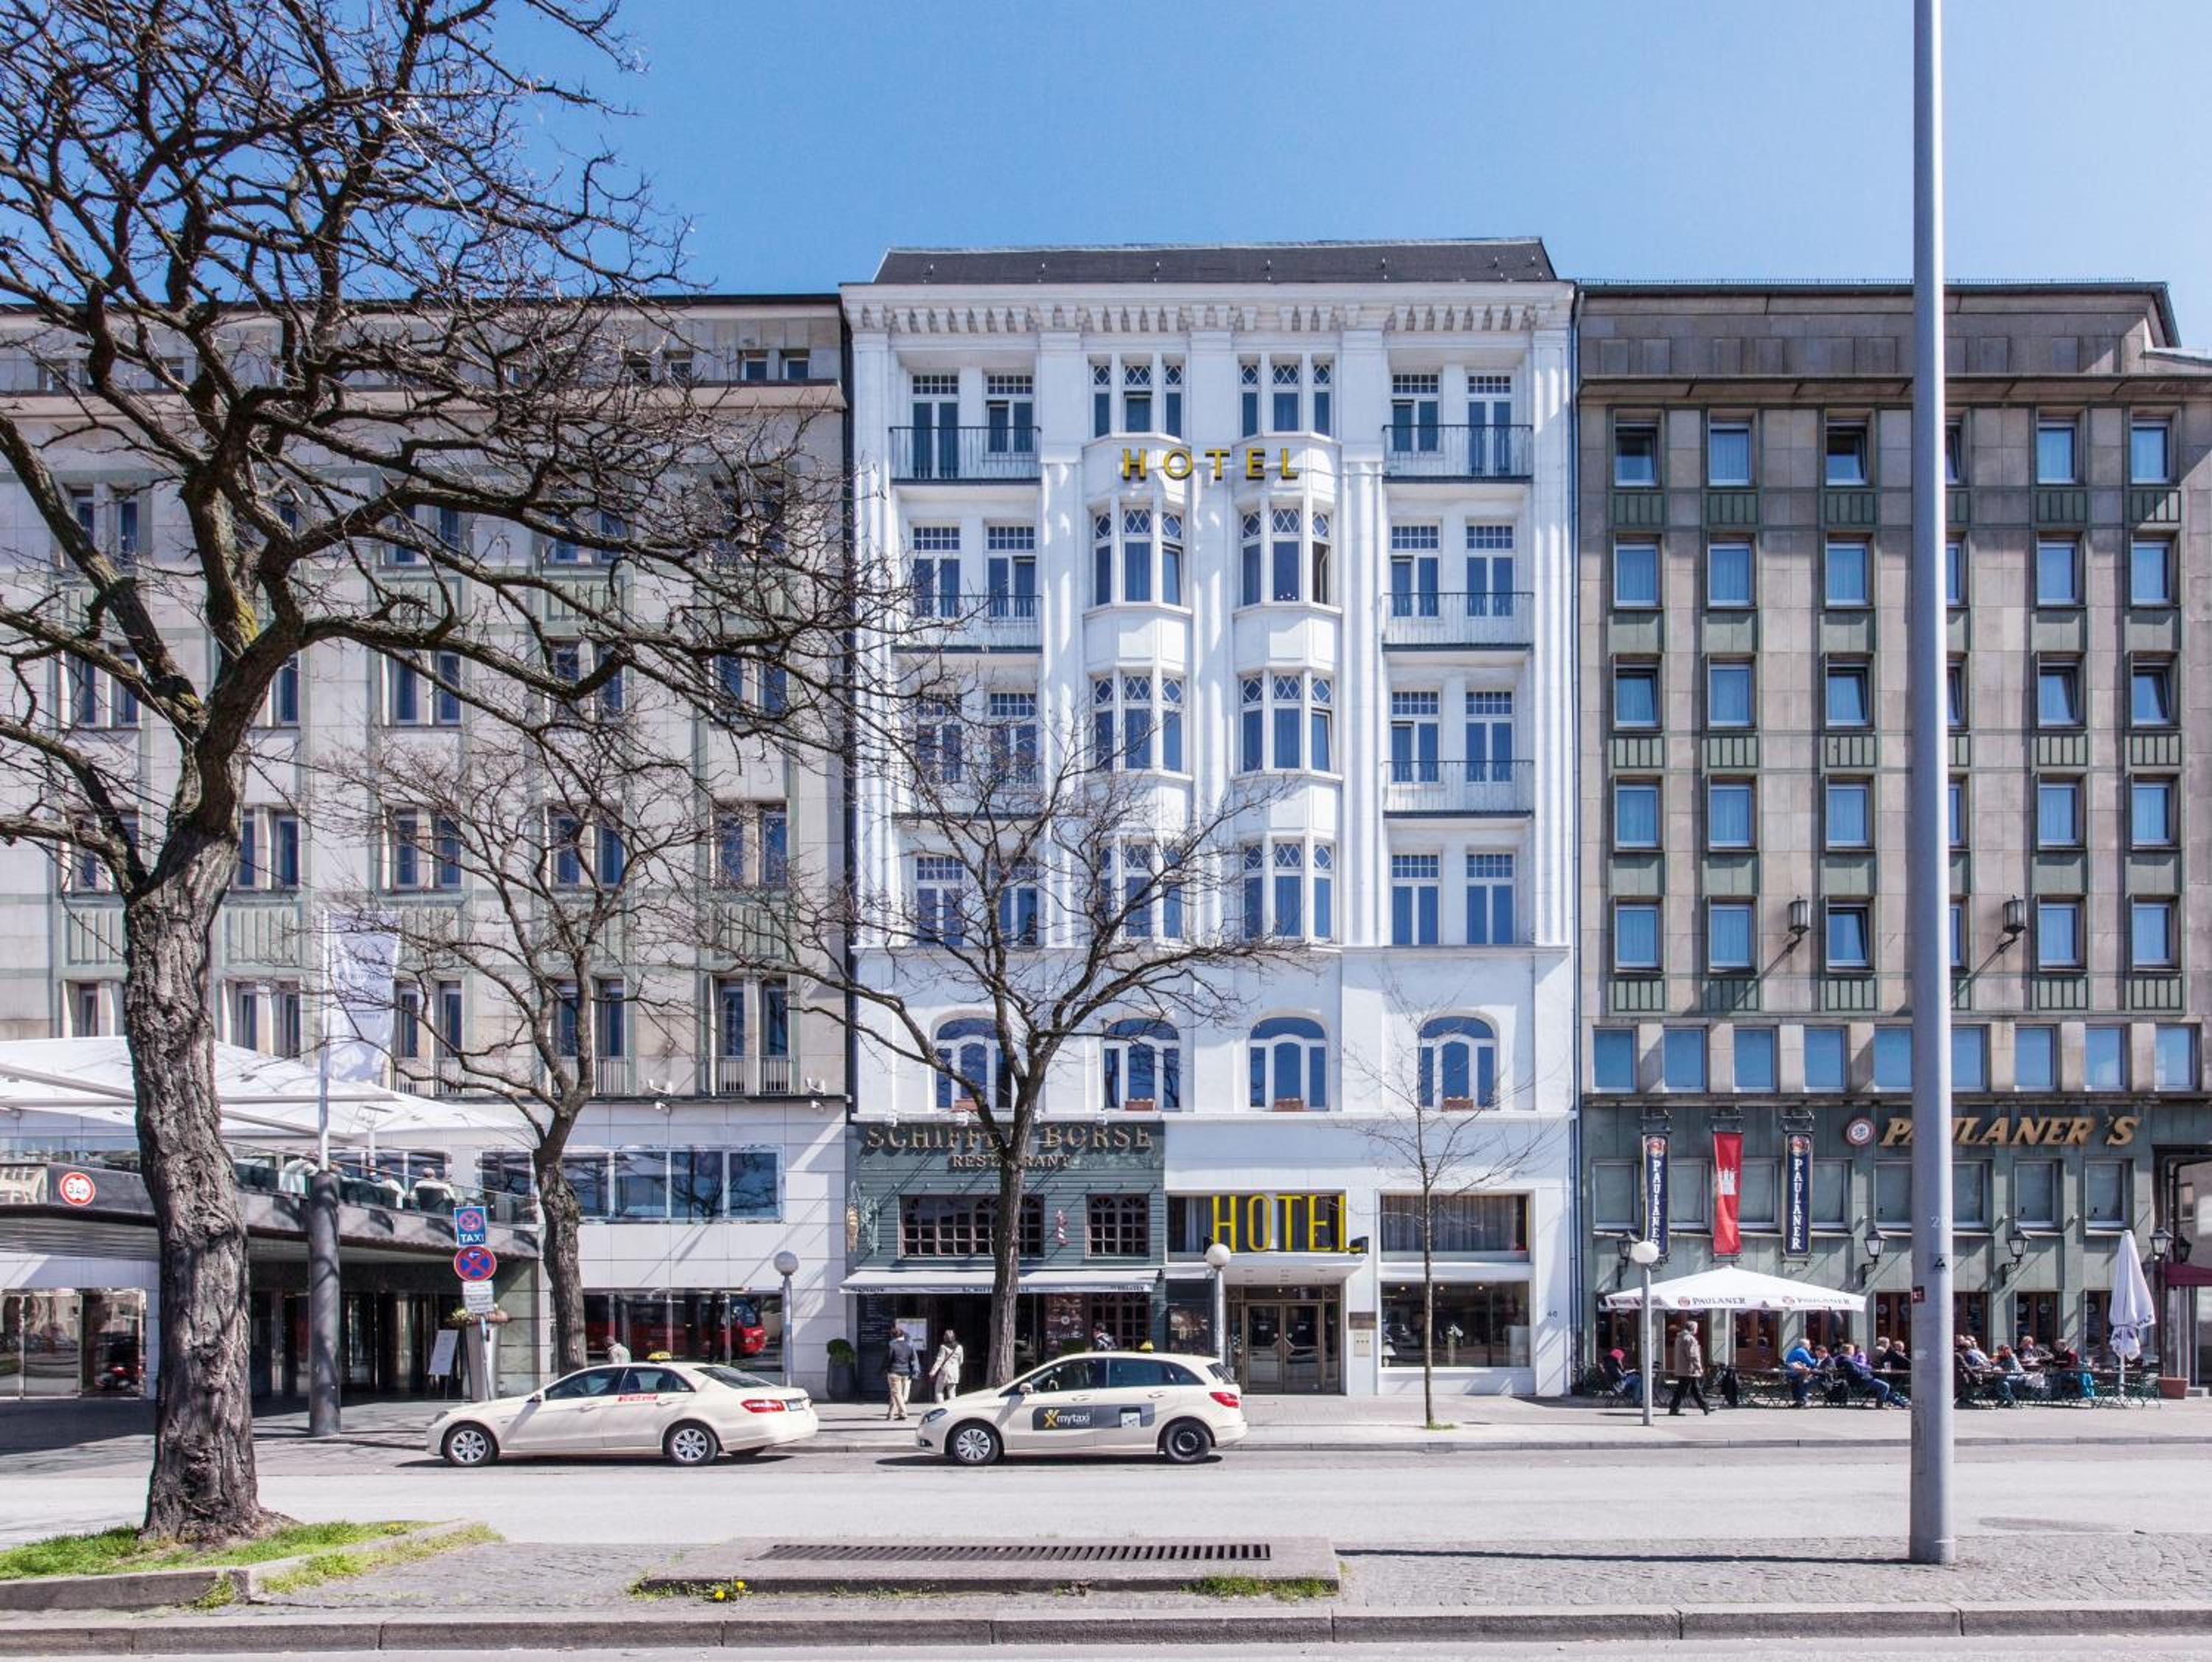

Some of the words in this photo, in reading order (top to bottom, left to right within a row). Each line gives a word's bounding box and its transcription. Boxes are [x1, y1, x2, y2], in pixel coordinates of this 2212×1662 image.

[1122, 448, 1299, 481] HOTEL
[867, 1124, 1018, 1148] SCHIFF
[1878, 1116, 2141, 1145] PLANER'S
[1791, 1158, 1804, 1251] PAULANER
[1213, 1192, 1362, 1252] HOTEL
[459, 1234, 484, 1243] TAXI
[1057, 1411, 1091, 1425] mytaxi
